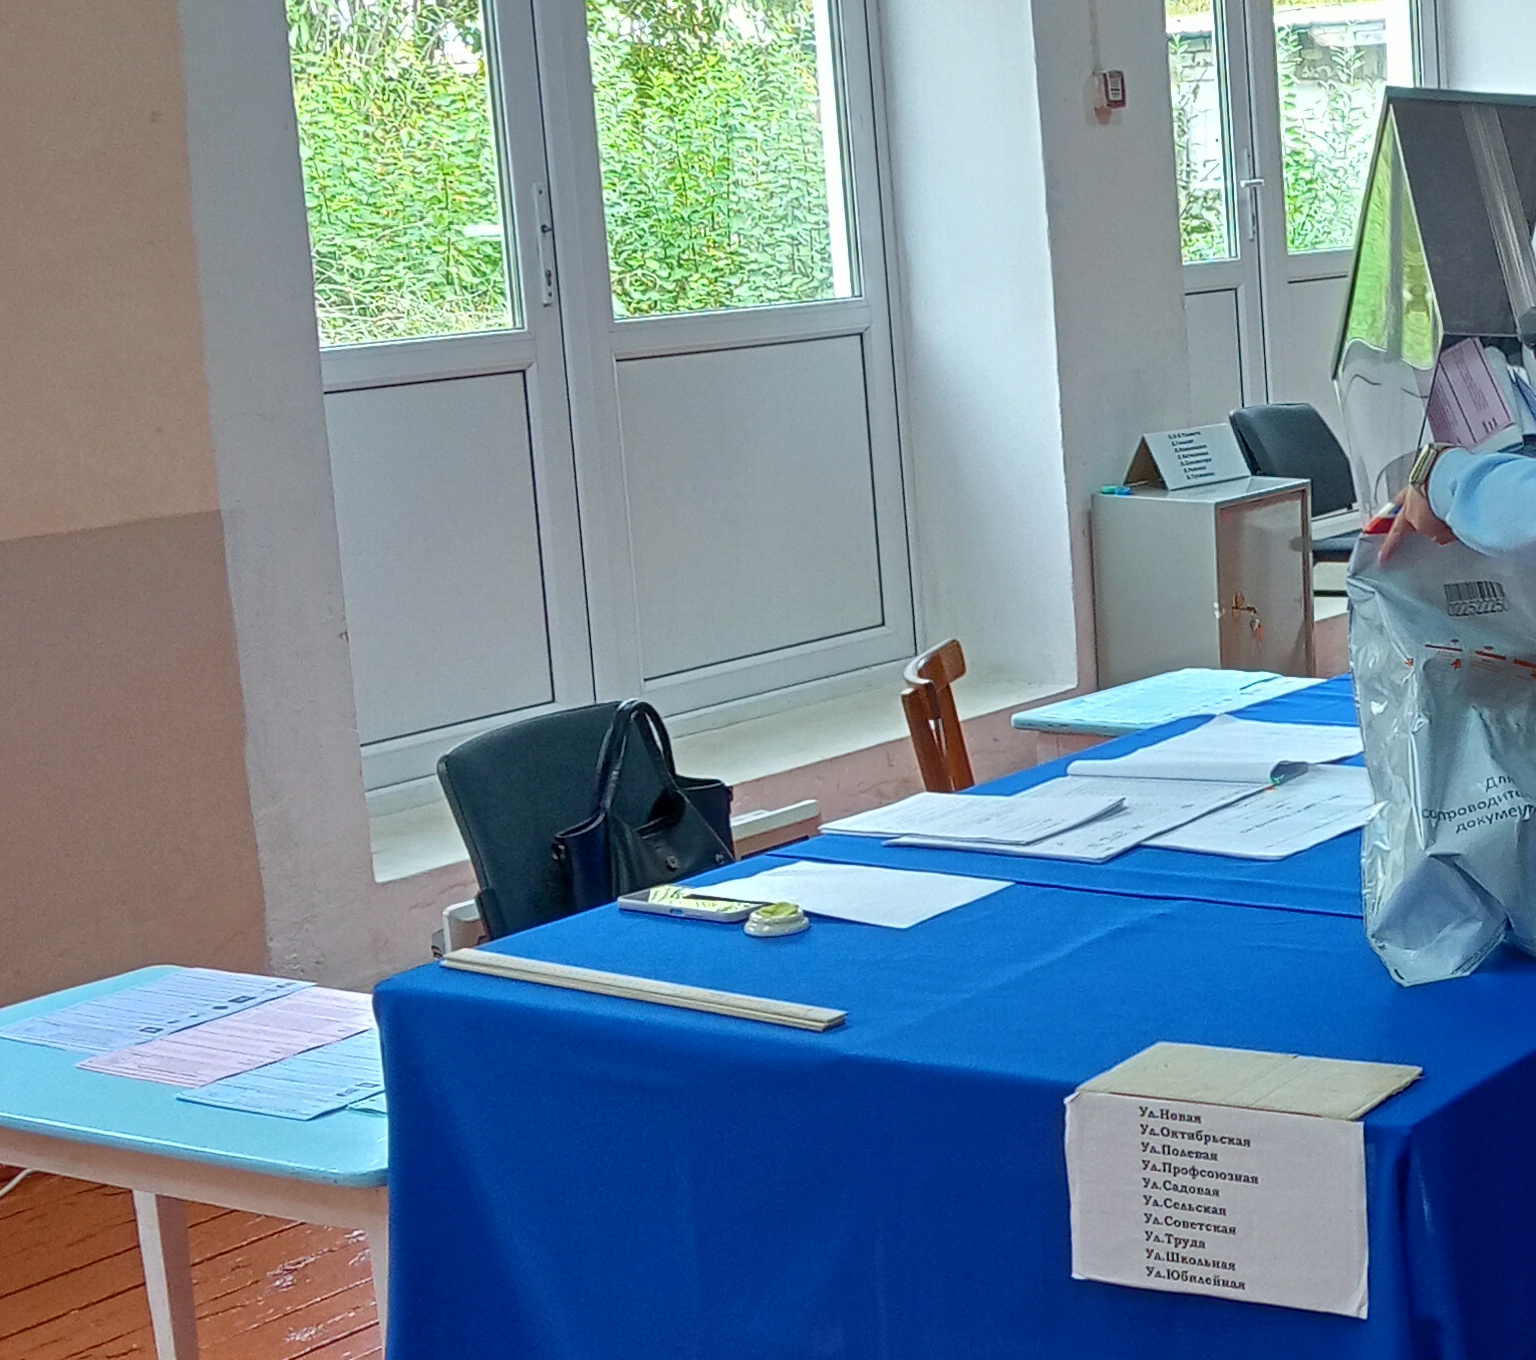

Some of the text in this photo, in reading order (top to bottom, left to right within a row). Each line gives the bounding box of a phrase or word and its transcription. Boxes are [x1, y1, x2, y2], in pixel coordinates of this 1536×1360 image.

[1139, 1105, 1202, 1125] Ул.Новая
[1140, 1123, 1251, 1148] Ул.Октябрьская
[1141, 1141, 1218, 1162] Ул.Полевая
[1141, 1159, 1259, 1185] Ул.Профсоюзная
[1142, 1177, 1221, 1198] Ул.Садовая
[1143, 1194, 1227, 1217] Ул.Сельская
[1143, 1212, 1237, 1236] Ул.Советская
[1144, 1230, 1206, 1250] Ул.Труда
[1145, 1248, 1236, 1272] Ул.Школьная
[1145, 1265, 1246, 1291] Ул.Юбилейная
